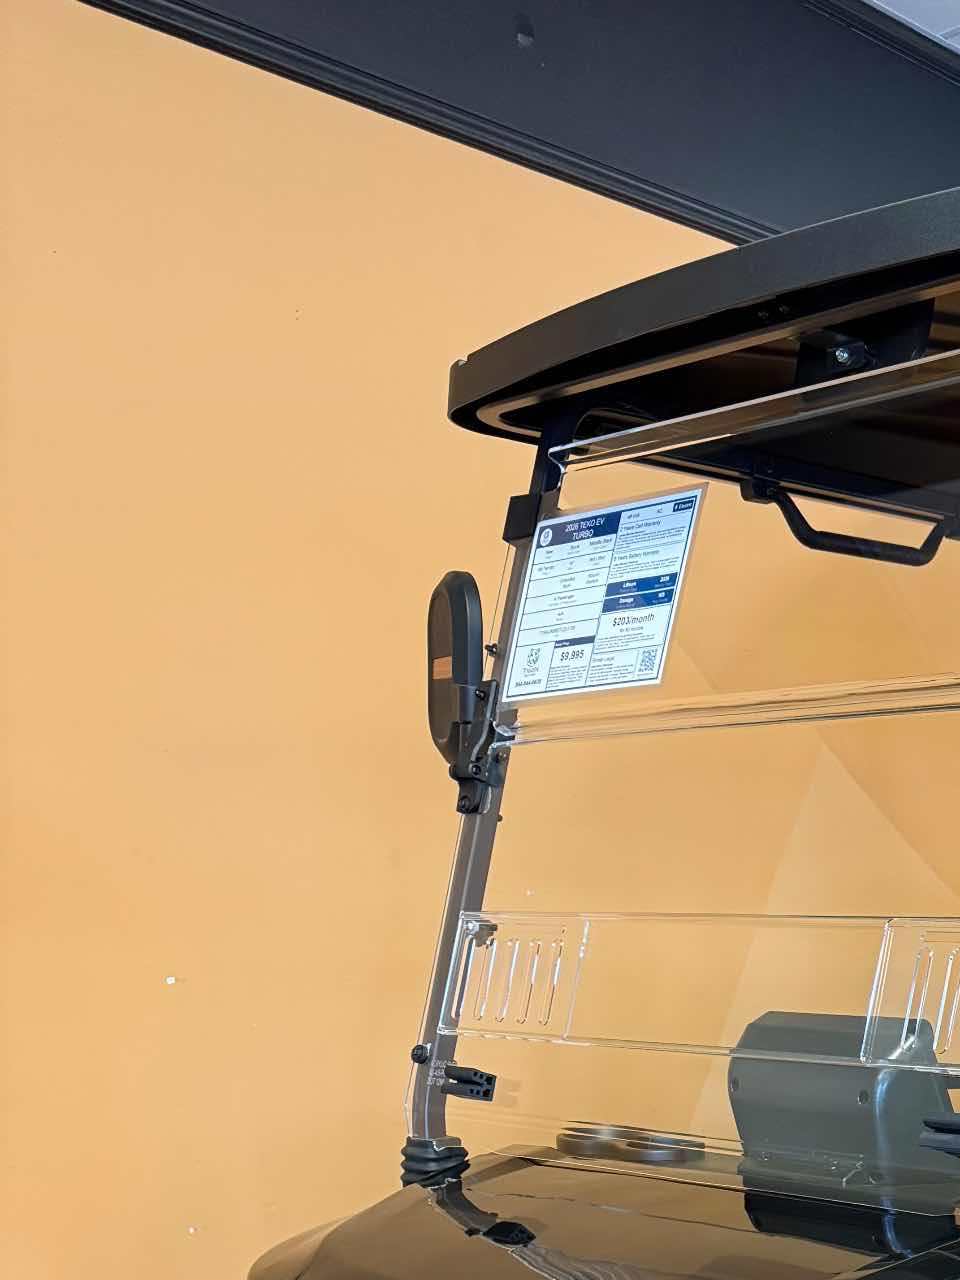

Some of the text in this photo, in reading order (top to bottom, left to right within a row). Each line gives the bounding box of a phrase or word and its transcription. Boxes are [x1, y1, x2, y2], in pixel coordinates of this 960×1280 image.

[596, 517, 606, 526] EV
[573, 529, 594, 540] TURBO
[612, 613, 655, 627] $203/month
[560, 649, 585, 661] $9,995
